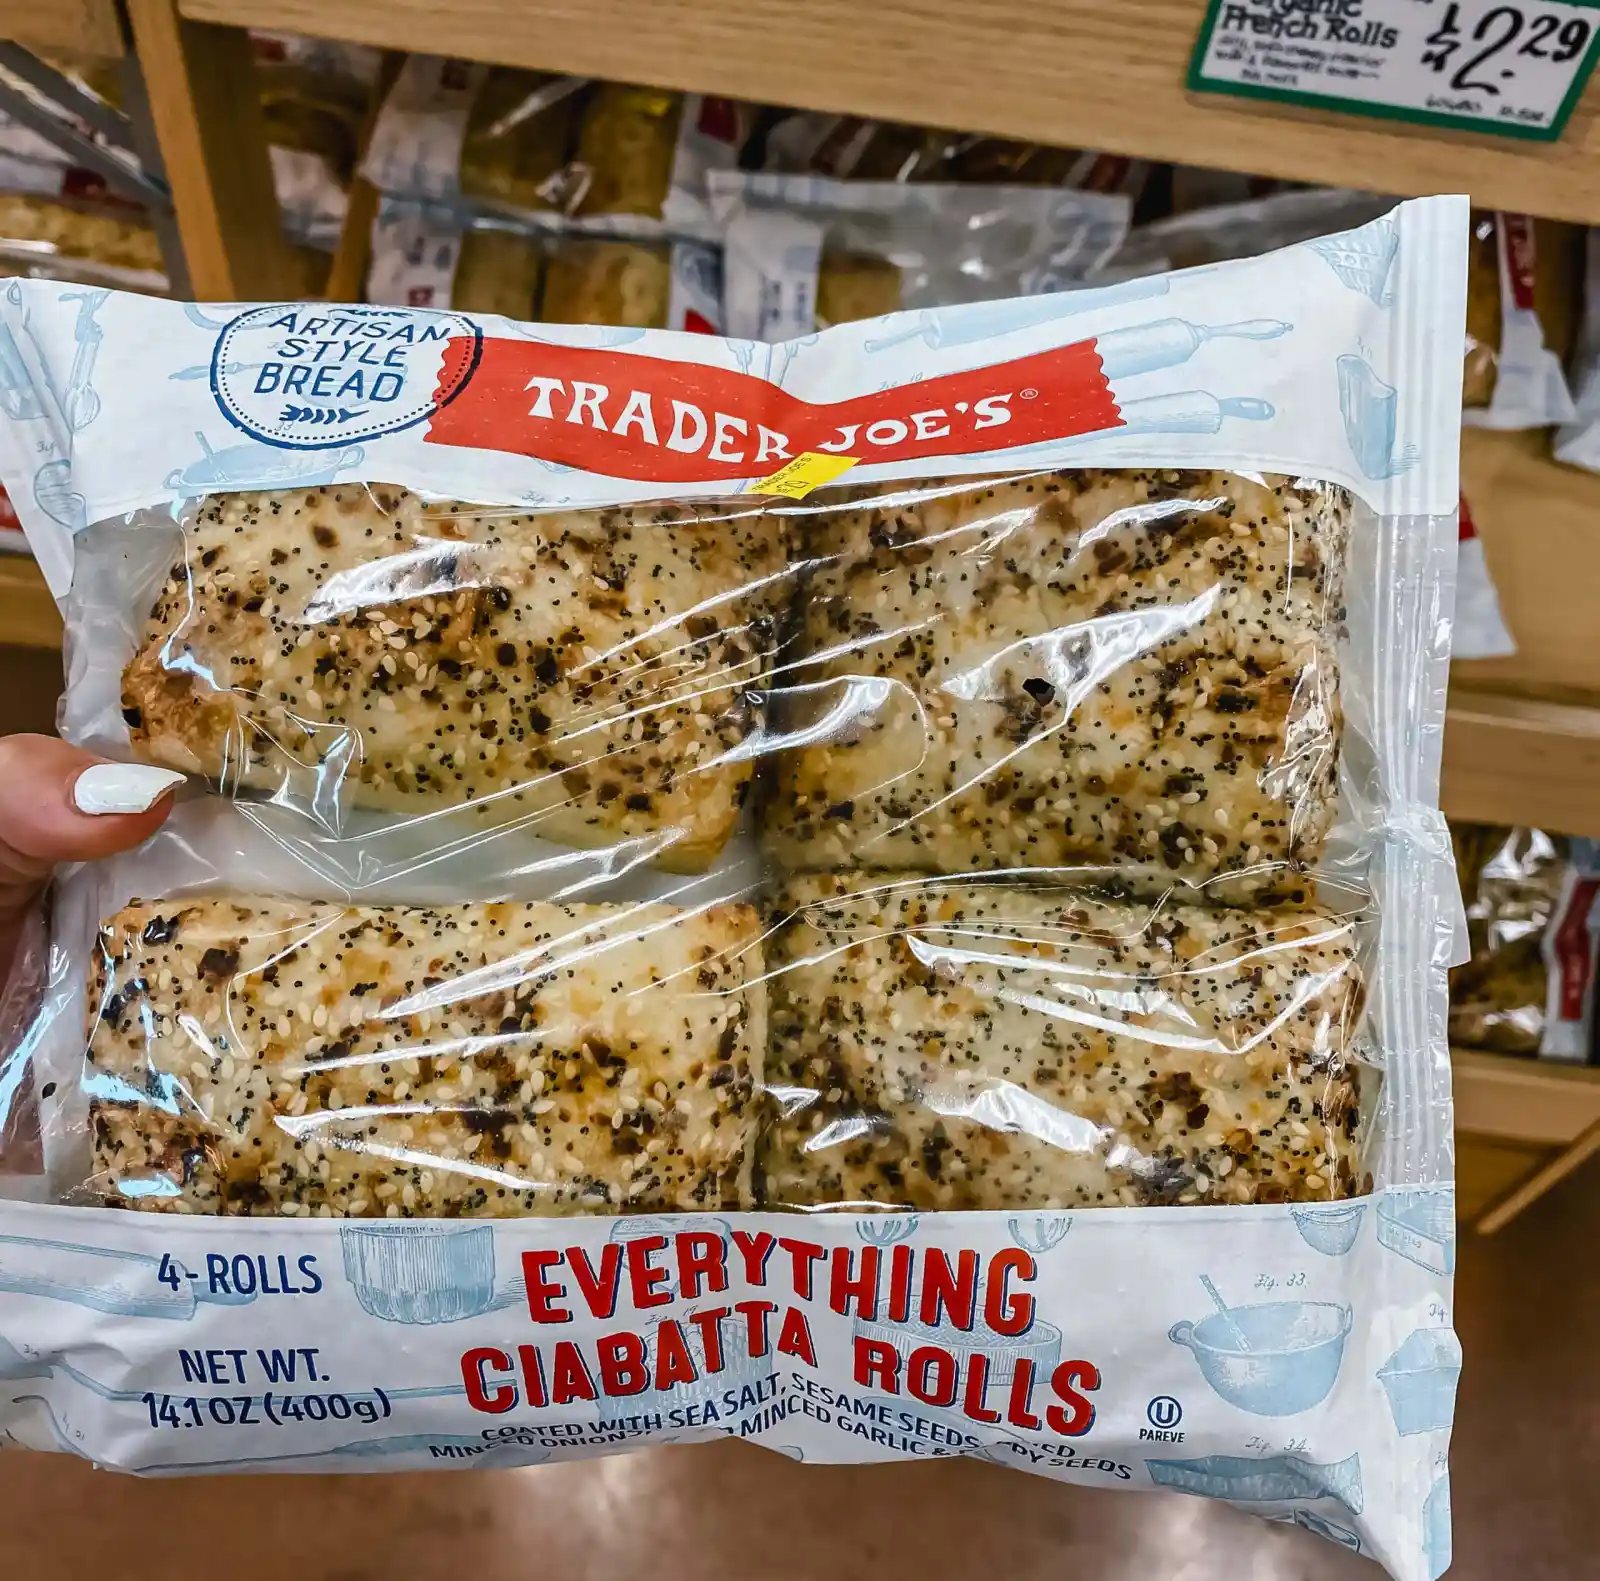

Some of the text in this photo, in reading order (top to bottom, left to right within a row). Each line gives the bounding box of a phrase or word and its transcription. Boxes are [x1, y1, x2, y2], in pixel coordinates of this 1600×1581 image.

[1222, 5, 1399, 49] French Rolls
[1253, 0, 1363, 18] rganic
[269, 312, 450, 343] ARTISAN
[277, 338, 414, 367] STYLE
[254, 363, 404, 402] BREAD
[524, 376, 1013, 462] TRADER JOE'S
[521, 1230, 1038, 1336] EVERYTHING
[179, 1348, 330, 1384] NET WT.
[460, 1300, 1102, 1437] CIABATTA ROLLS
[143, 1387, 391, 1428] 14.1 OZ (400g)
[481, 1424, 583, 1440] COATED
[588, 1413, 662, 1434] WITH
[669, 1400, 720, 1428] SEA
[723, 1372, 786, 1416] SALT,
[792, 1372, 892, 1426] SESAME
[741, 1394, 831, 1437] MINCED
[837, 1415, 926, 1455] GARLIC
[932, 1447, 950, 1456] &
[1139, 1428, 1185, 1443] PAREVE
[1048, 1458, 1132, 1480] SEEDS
